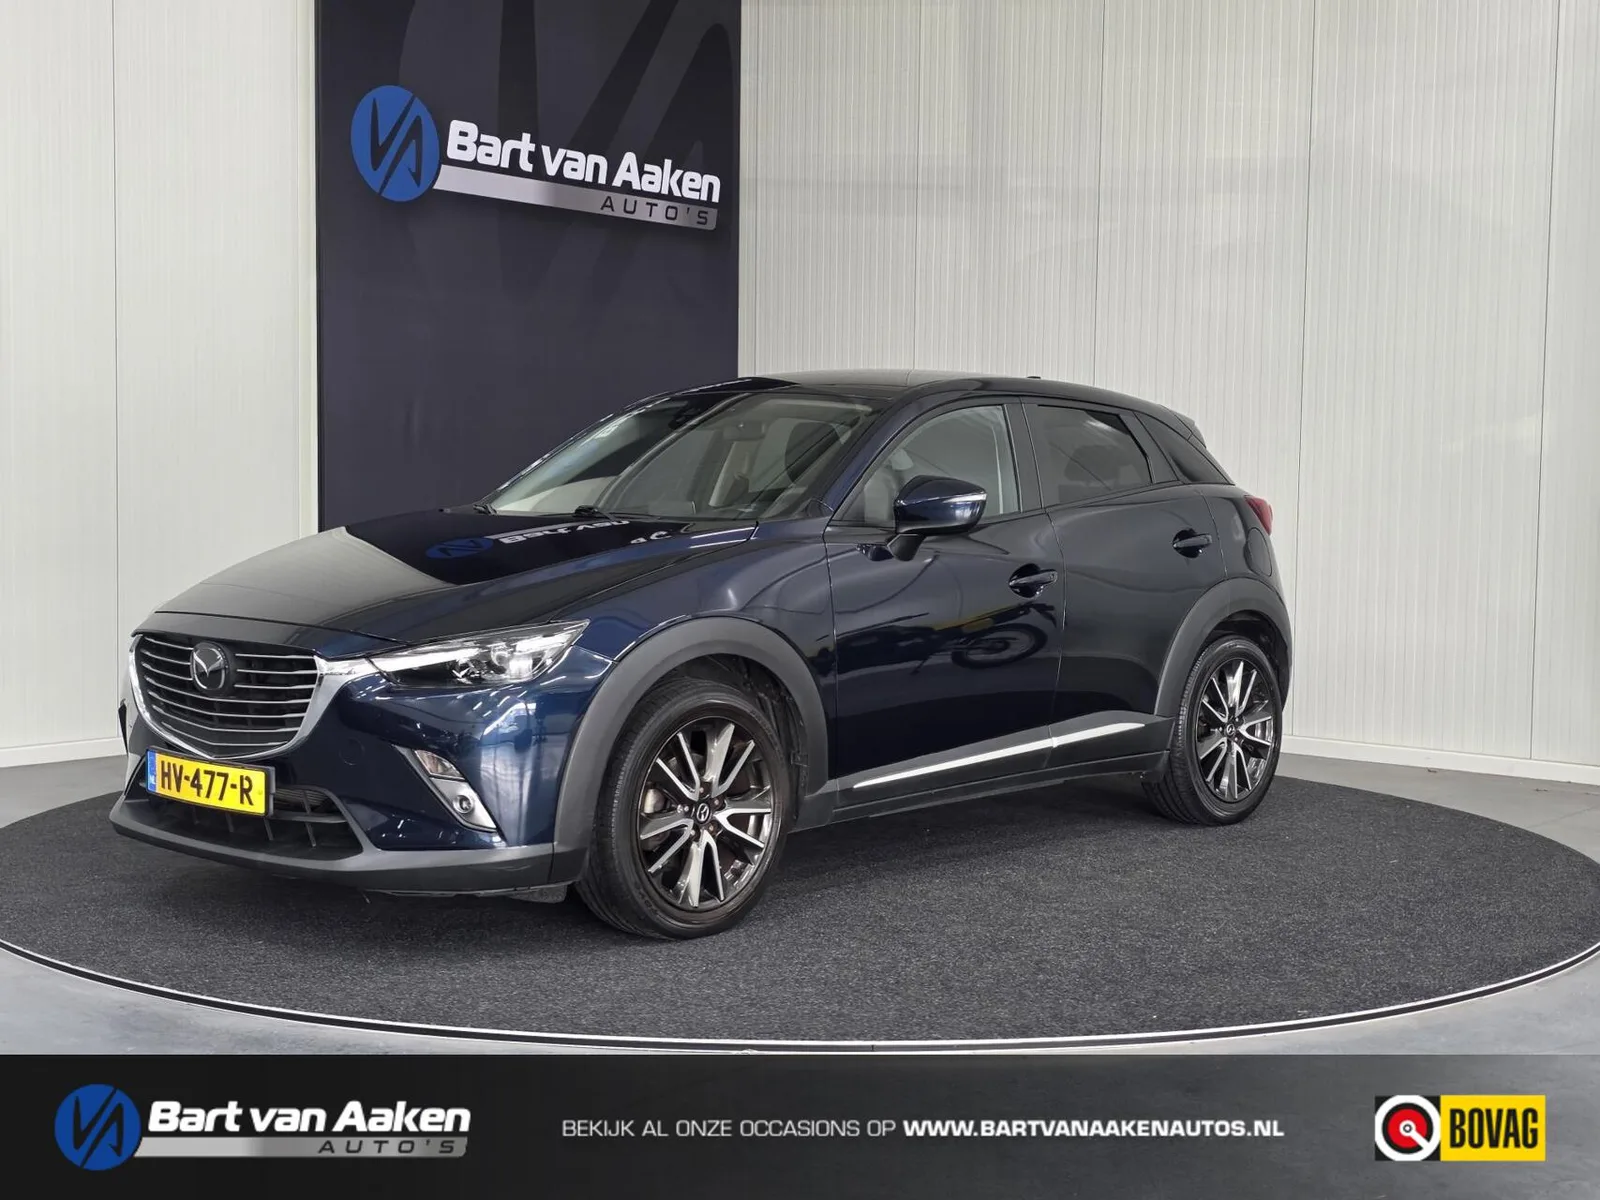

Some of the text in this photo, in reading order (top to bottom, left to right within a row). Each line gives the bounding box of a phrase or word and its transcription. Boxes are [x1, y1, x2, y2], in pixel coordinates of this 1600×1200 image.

[446, 119, 721, 203] Bart van Aaken
[600, 196, 709, 226] AUTO'S
[160, 760, 254, 806] HV-477-R
